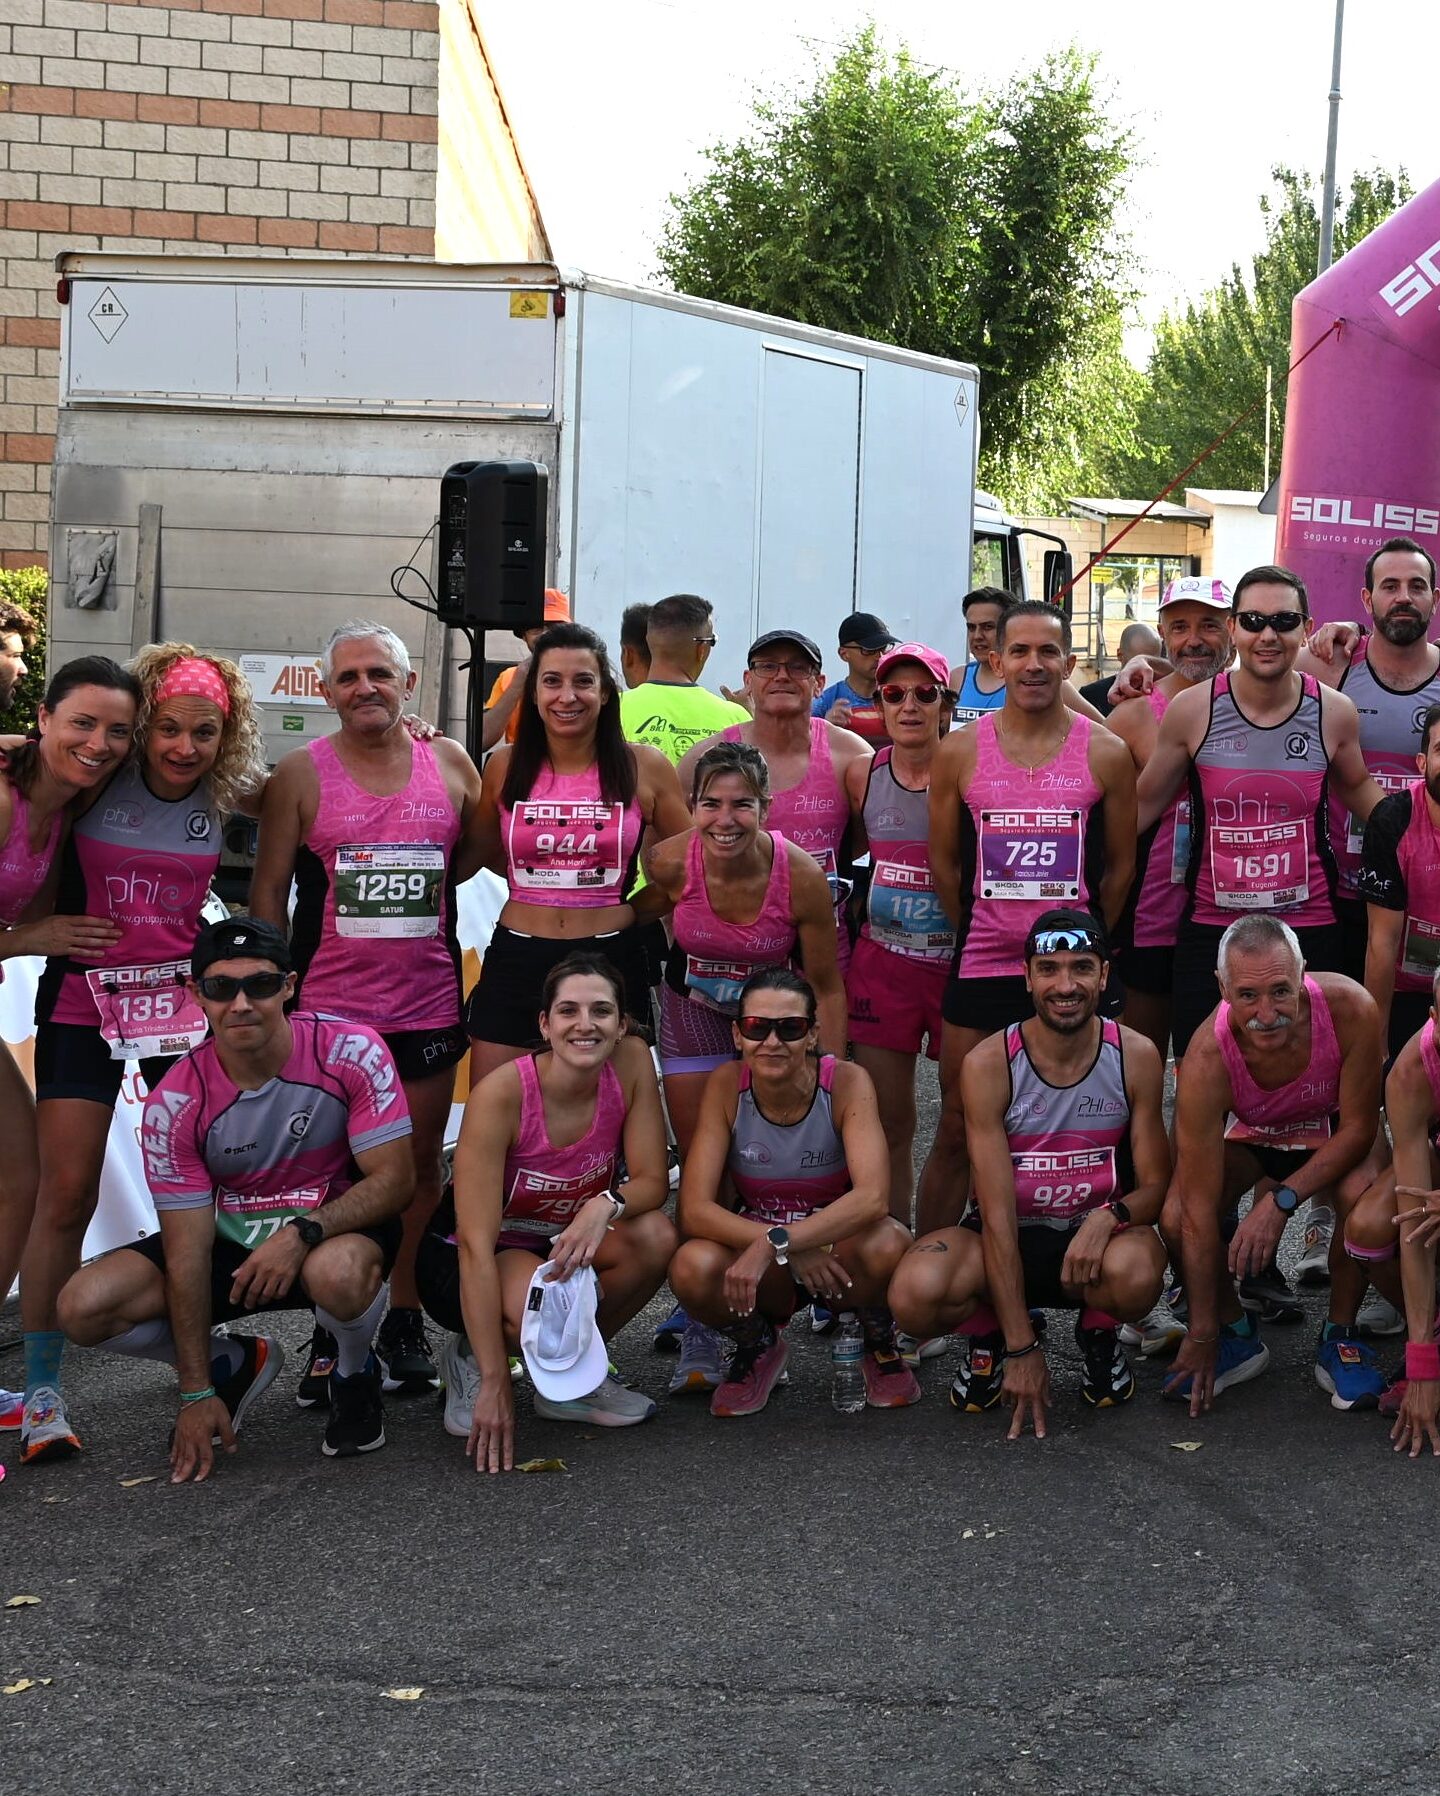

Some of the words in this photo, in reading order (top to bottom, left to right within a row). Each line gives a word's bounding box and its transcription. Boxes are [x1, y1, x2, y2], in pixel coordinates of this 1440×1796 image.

[102, 303, 113, 313] CR
[1291, 496, 1439, 535] SOLISS
[1304, 531, 1347, 543] Seguros
[1354, 536, 1386, 546] desd
[523, 806, 612, 820] SOLISS
[990, 814, 1072, 827] SOLISS
[1219, 826, 1297, 843] SOLISS
[536, 834, 598, 855] 944
[1005, 841, 1058, 866] 725
[340, 852, 373, 862] BigMat
[1234, 852, 1291, 878] 1691
[882, 868, 933, 886] SOLI
[1251, 881, 1278, 890] Eugenio
[355, 874, 426, 901] 1259
[119, 993, 174, 1022] 135
[233, 1142, 257, 1154] TACTIC
[1018, 1152, 1104, 1171] SOLISS
[525, 1166, 608, 1192] SOLISS
[1032, 1183, 1092, 1207] 923
